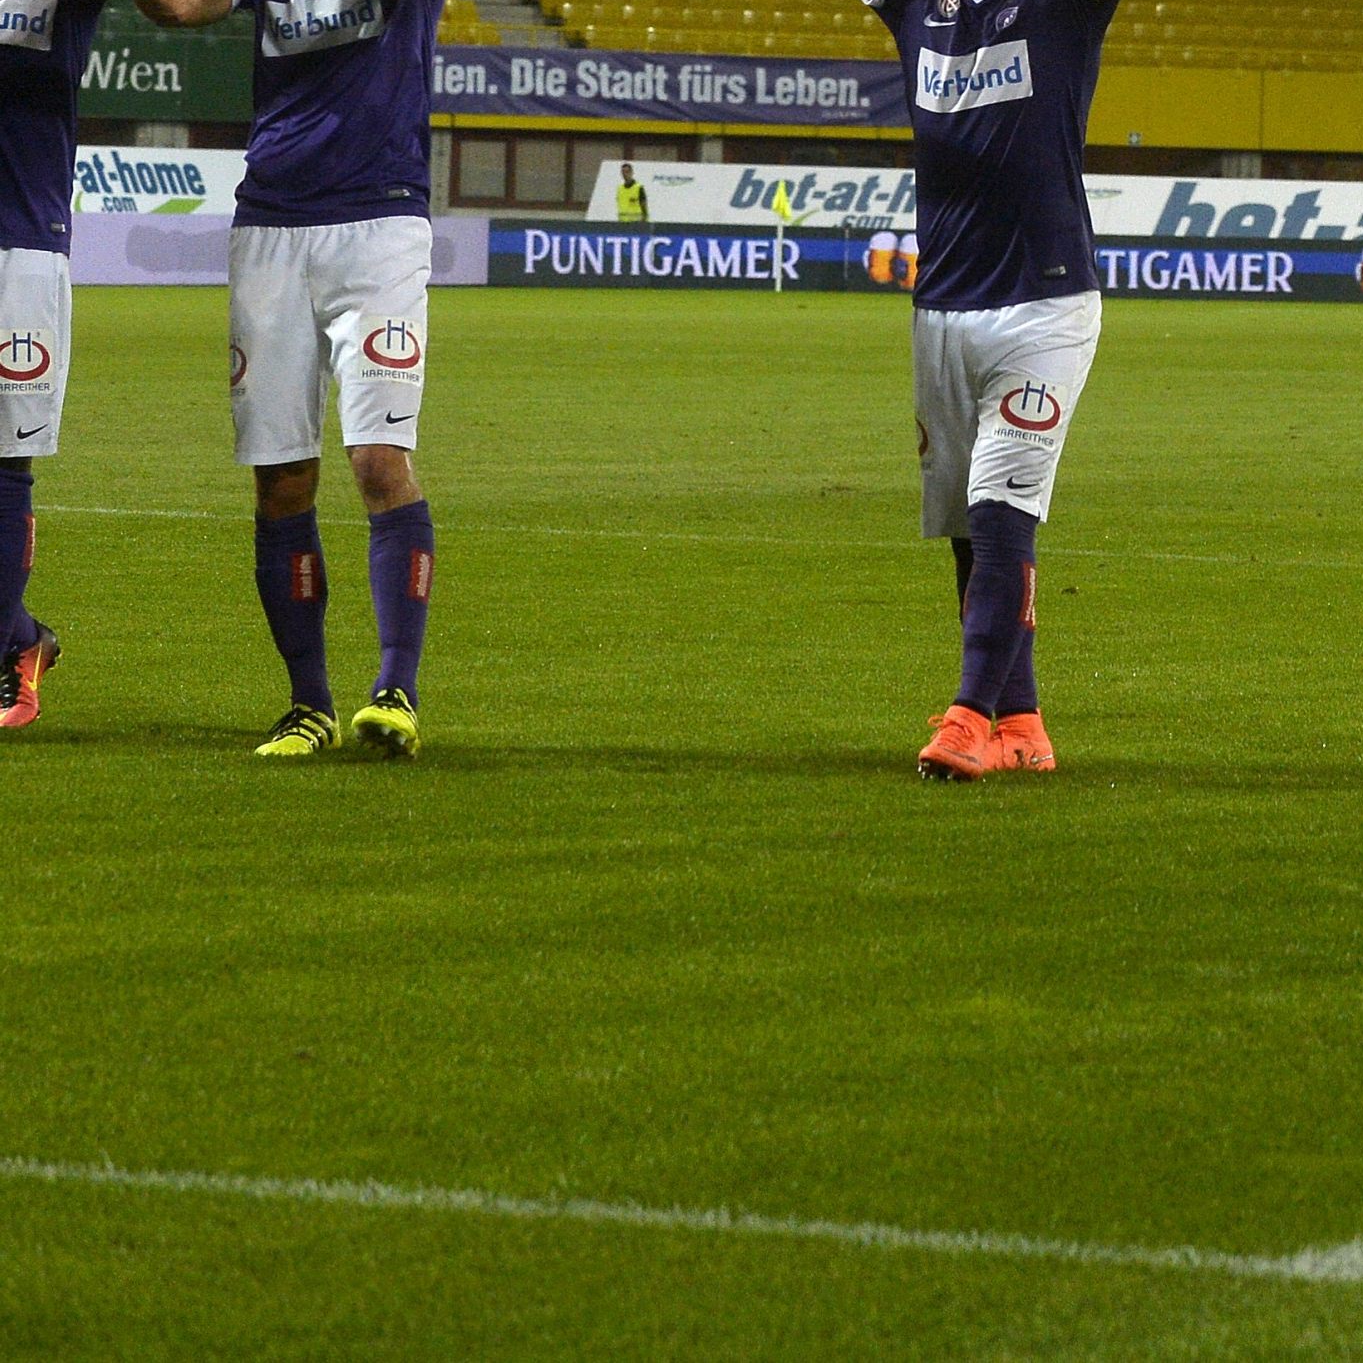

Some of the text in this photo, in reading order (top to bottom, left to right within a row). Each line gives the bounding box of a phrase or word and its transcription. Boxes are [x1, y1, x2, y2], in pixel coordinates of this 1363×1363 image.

[510, 57, 567, 98] Die
[575, 58, 669, 102] Stadt
[677, 64, 748, 105] fürs
[755, 66, 871, 108] Leben.
[923, 55, 1023, 99] Verbund
[101, 195, 139, 214] .com
[524, 228, 801, 282] PUNTIGAMER
[1094, 249, 1294, 294] TIGAMER
[993, 427, 1054, 447] HARREITHER
